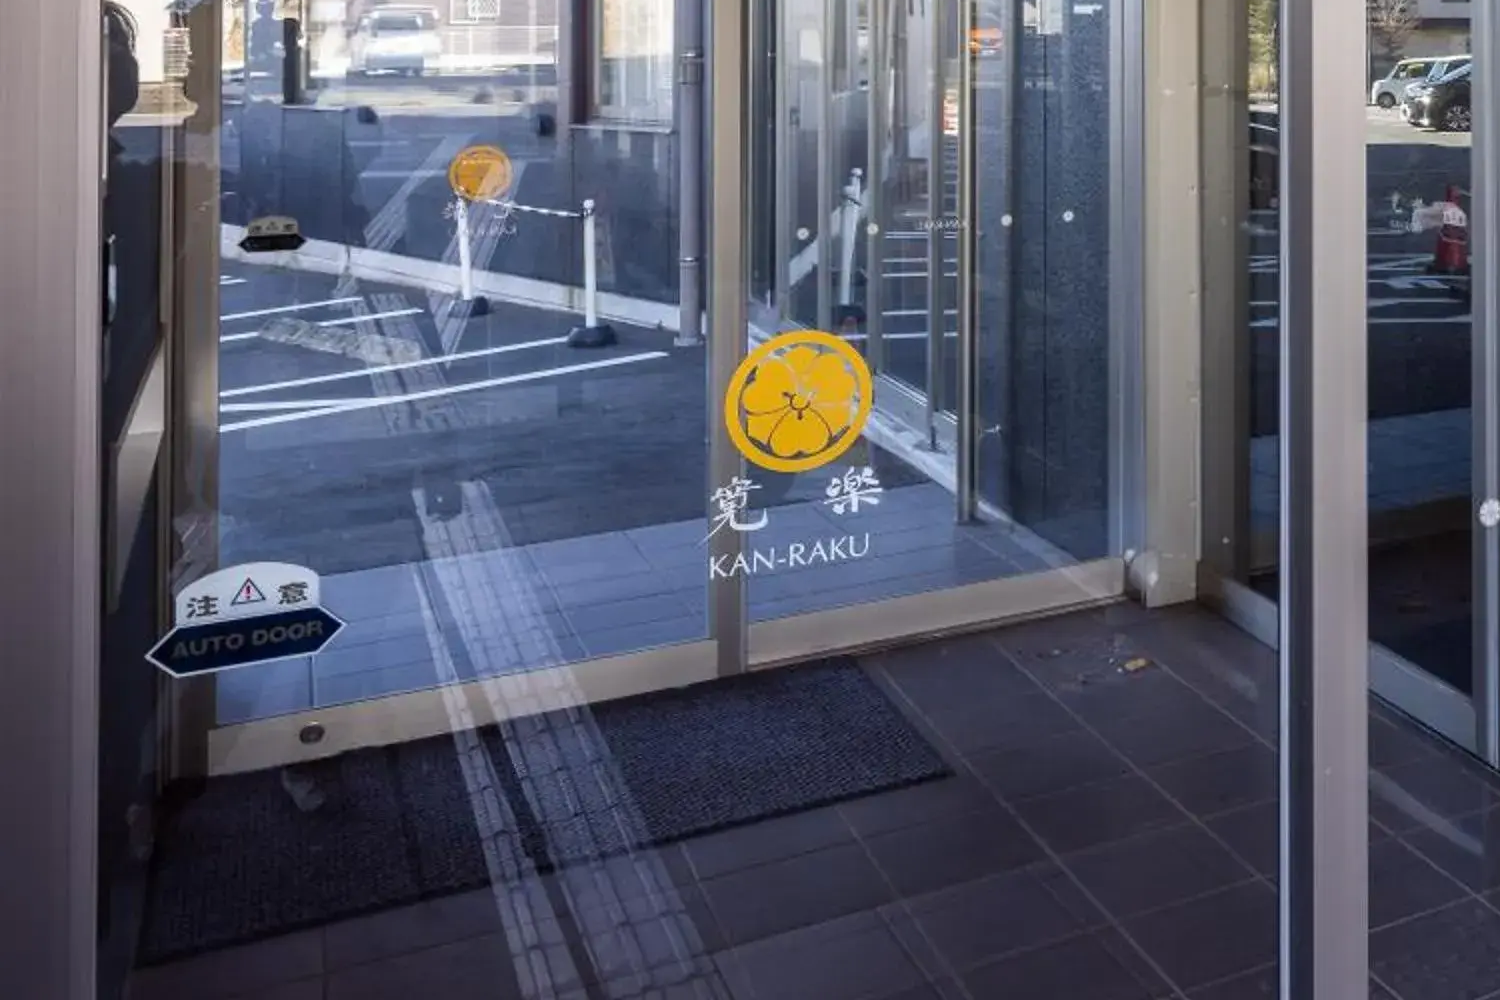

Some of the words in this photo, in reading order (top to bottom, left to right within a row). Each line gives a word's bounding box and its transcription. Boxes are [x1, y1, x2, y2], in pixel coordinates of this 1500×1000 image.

[709, 532, 870, 580] KAN-RAKU
[171, 632, 245, 659] AUTO
[252, 620, 324, 646] DOOR
